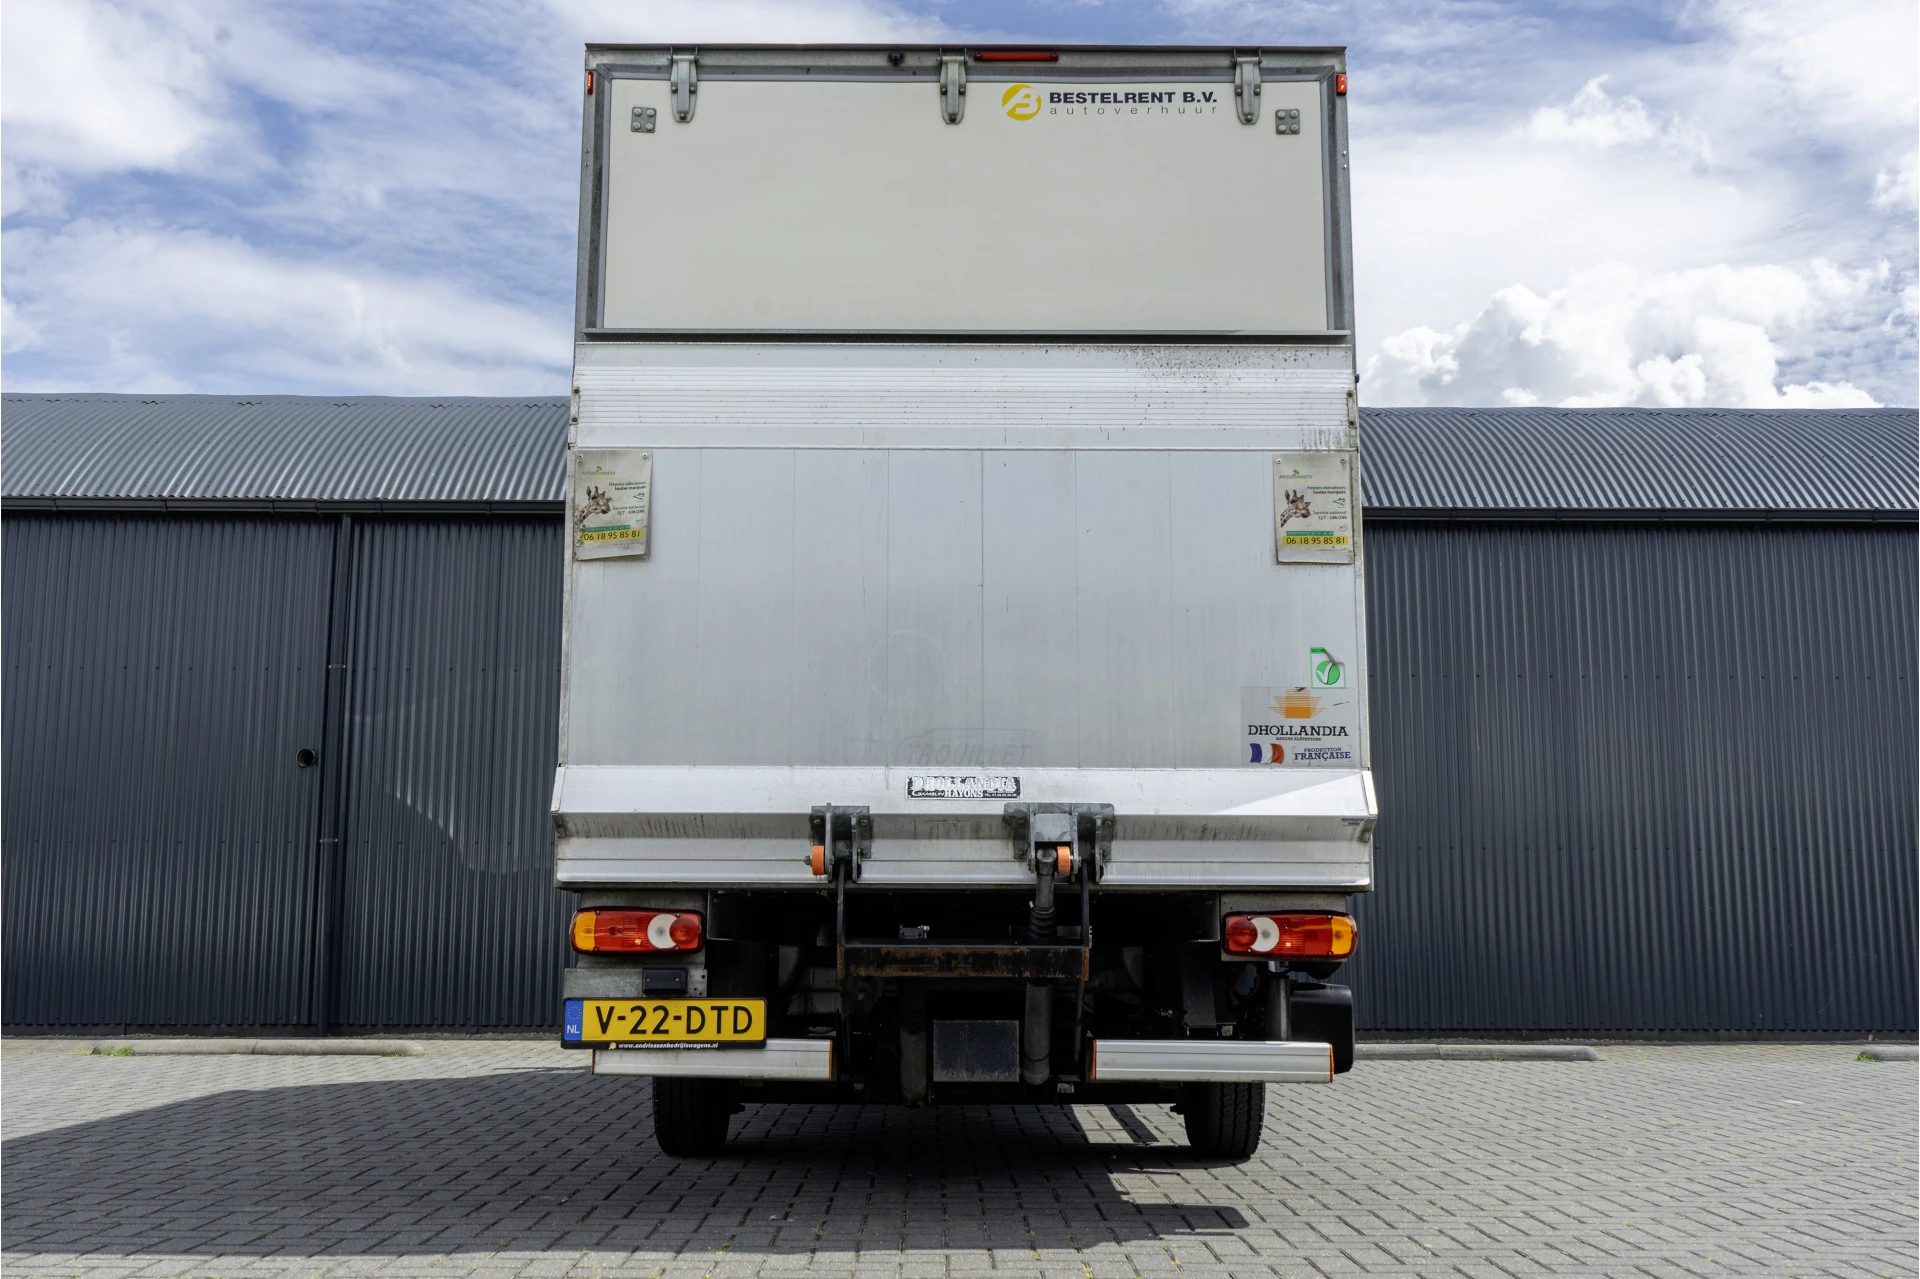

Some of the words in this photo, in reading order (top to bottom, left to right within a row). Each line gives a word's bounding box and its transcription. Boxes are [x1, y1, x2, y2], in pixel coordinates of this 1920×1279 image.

[1050, 92, 1176, 104] BESTELRENT
[1182, 91, 1218, 104] B.V.
[1050, 105, 1217, 115] autoverhuur
[584, 533, 594, 541] 06
[597, 532, 606, 540] 18
[631, 530, 640, 538] 81
[1286, 537, 1297, 545] 06
[1300, 537, 1309, 545] 18
[1311, 537, 1321, 545] 95
[1248, 724, 1349, 737] DHOLLANDIA
[1294, 751, 1351, 762] FRANÇAISE
[944, 789, 984, 798] HAYONS
[595, 1005, 753, 1035] V-22-DTD
[566, 1024, 580, 1034] NL
